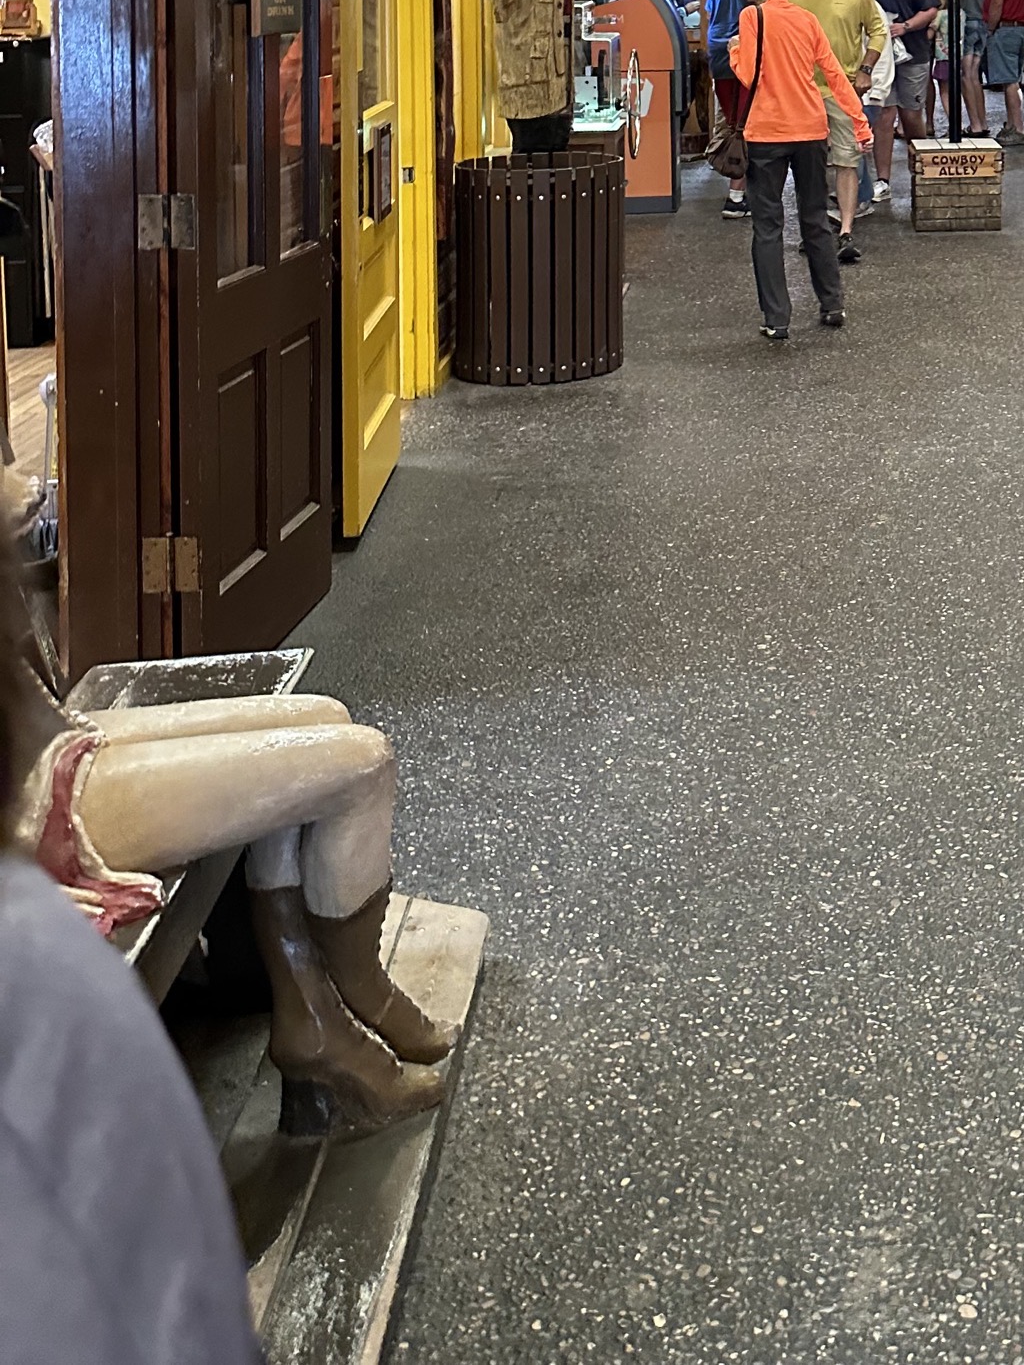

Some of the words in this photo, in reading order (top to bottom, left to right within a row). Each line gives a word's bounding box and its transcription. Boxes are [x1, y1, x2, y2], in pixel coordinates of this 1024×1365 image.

[267, 5, 294, 17] DRINK
[931, 155, 986, 166] COWBOY
[939, 166, 979, 176] ALLEY
